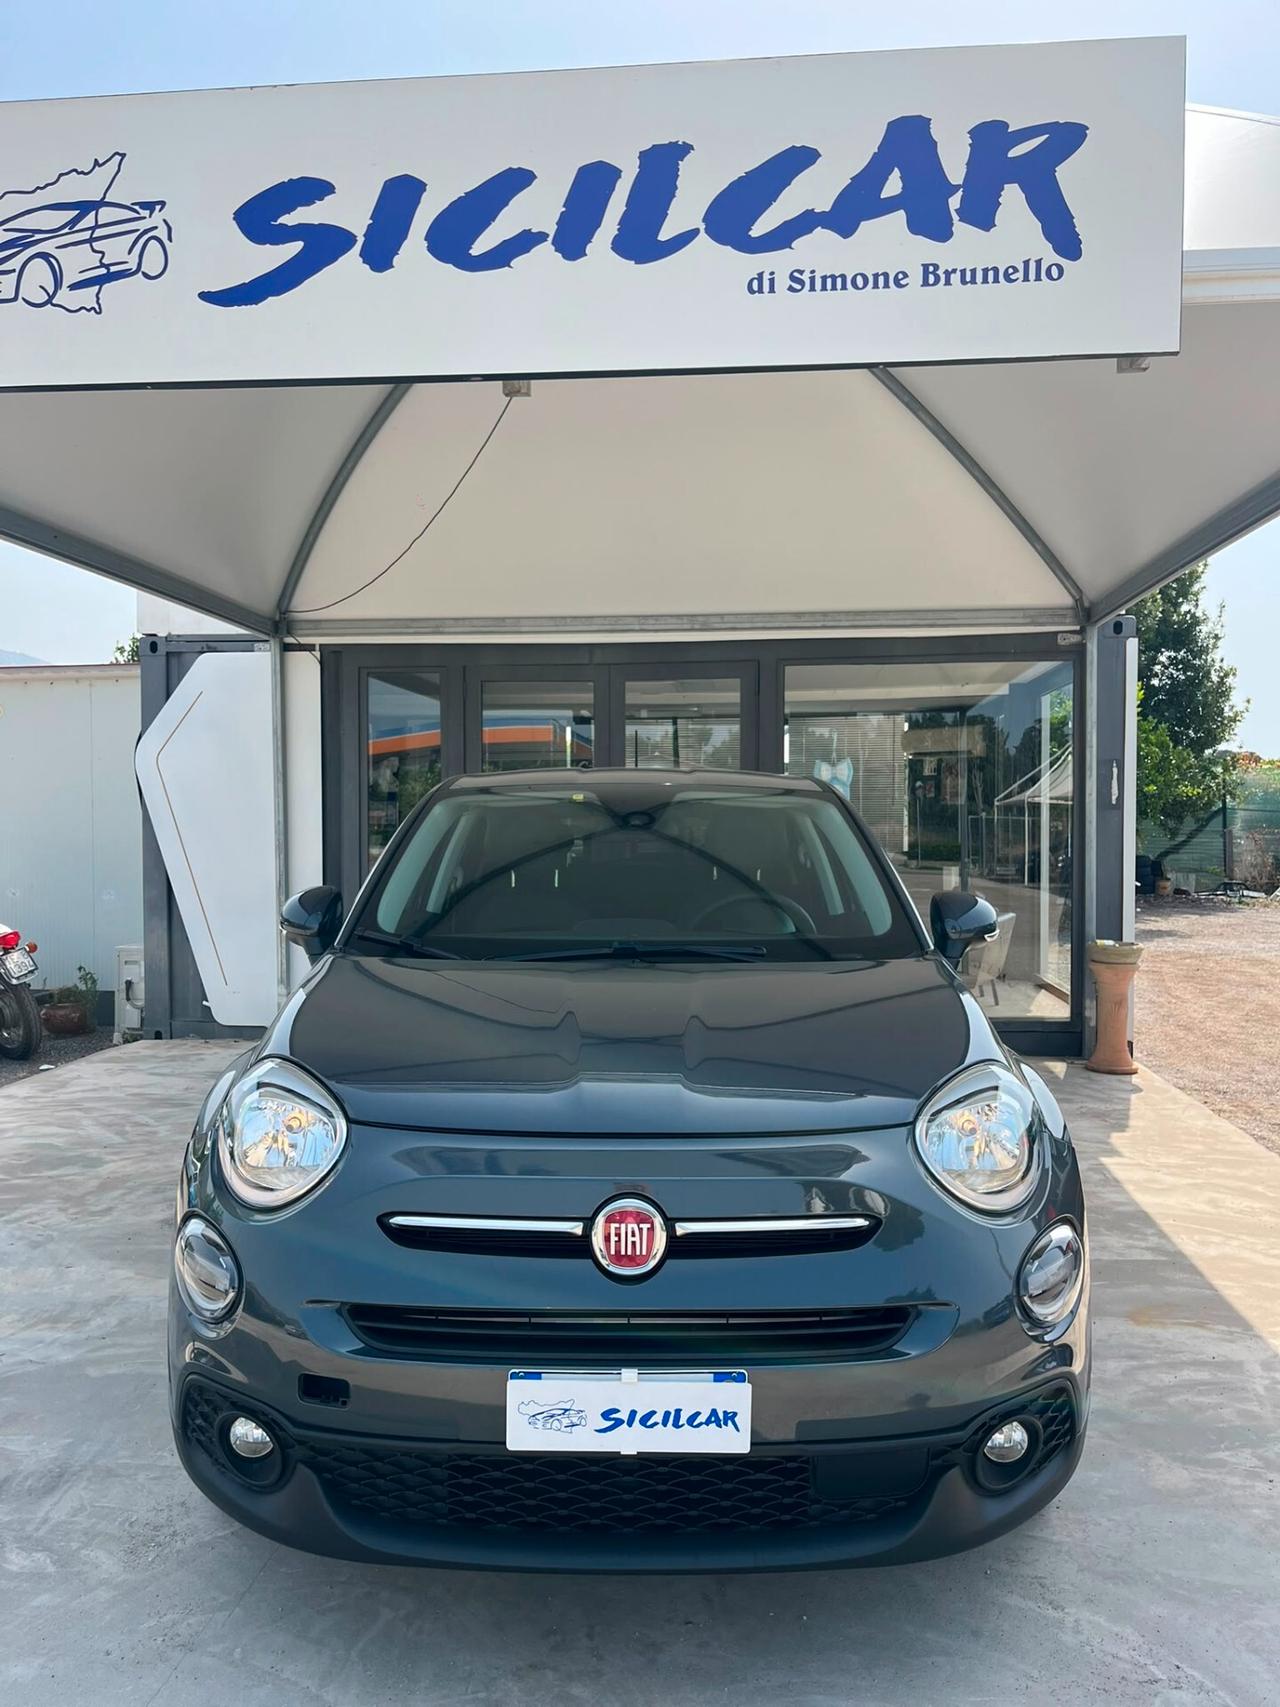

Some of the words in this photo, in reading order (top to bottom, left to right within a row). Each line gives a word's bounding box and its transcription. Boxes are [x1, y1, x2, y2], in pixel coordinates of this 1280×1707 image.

[199, 115, 1088, 307] SICILCAR
[747, 271, 776, 295] di
[786, 268, 909, 293] Simone
[920, 257, 1064, 288] Brunello
[609, 1222, 652, 1256] FIAT
[593, 1407, 741, 1434] SICILCAR
